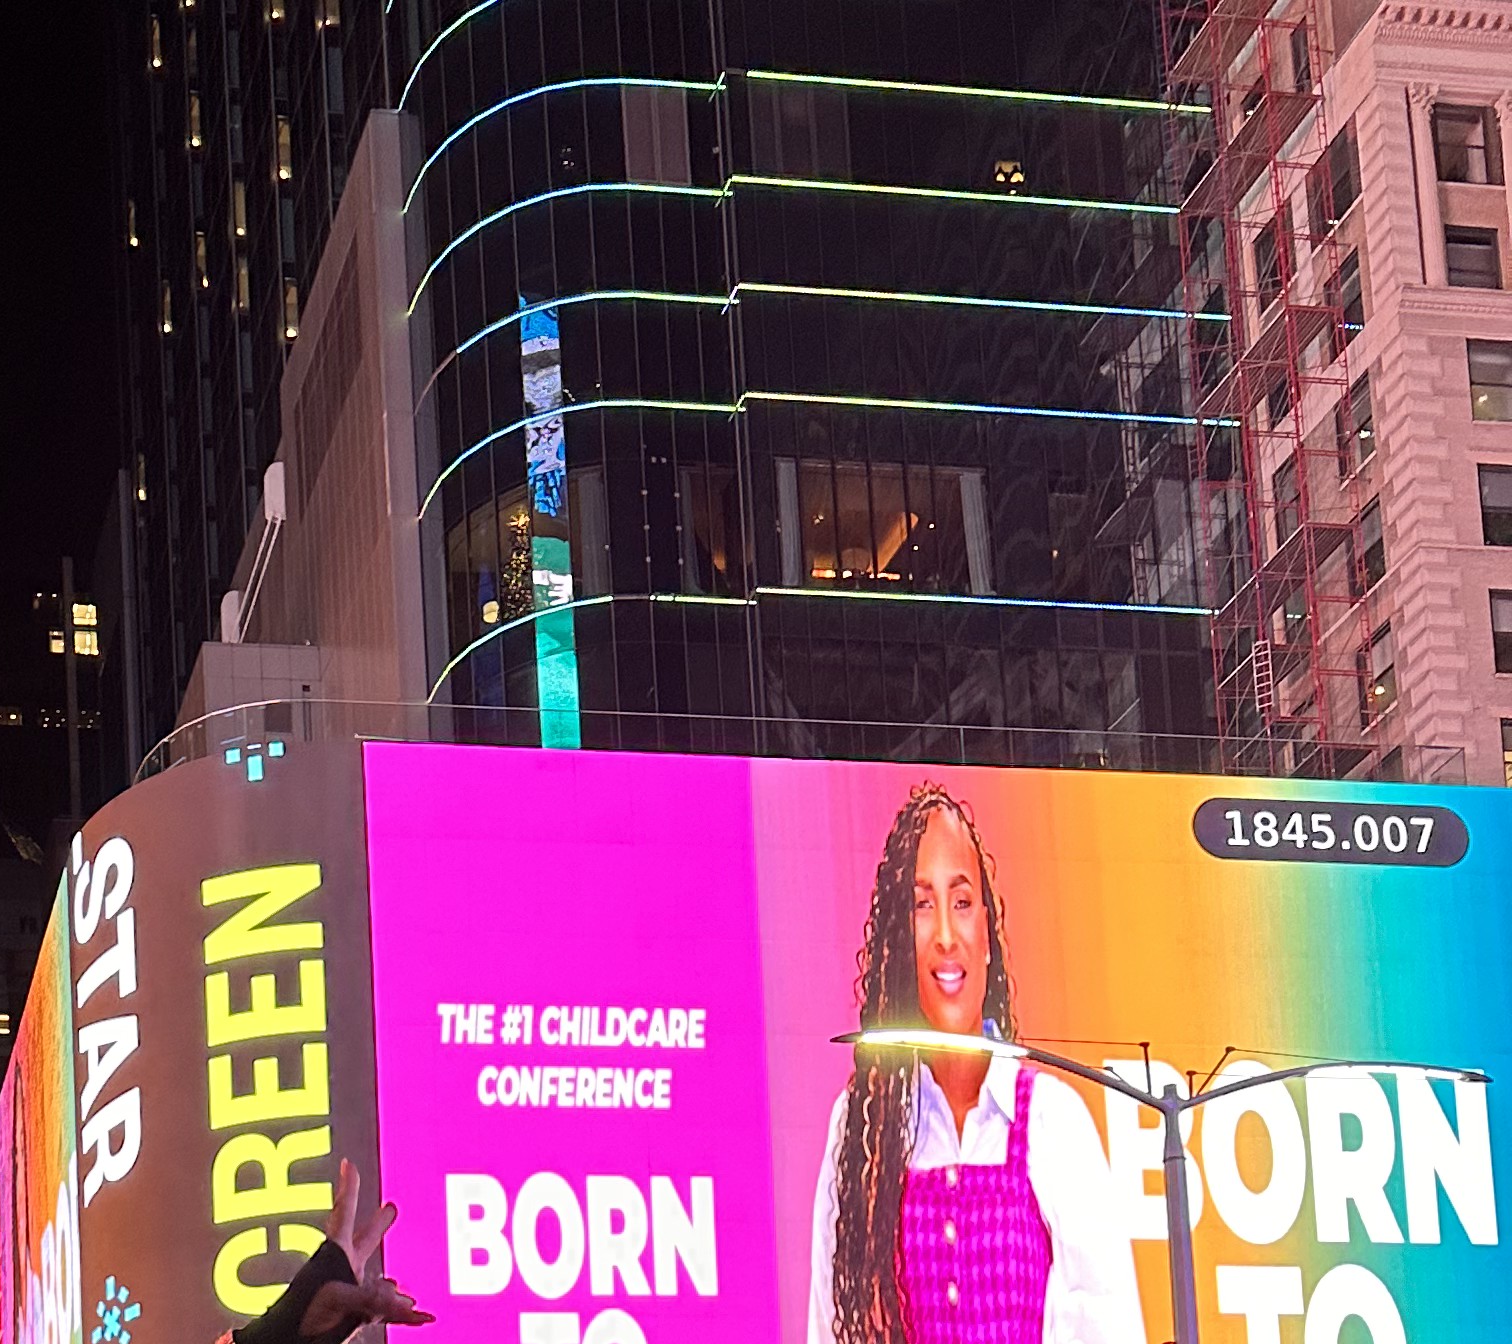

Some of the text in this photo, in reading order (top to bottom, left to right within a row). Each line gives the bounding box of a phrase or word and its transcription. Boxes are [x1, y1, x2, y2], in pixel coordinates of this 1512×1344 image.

[1224, 809, 1435, 854] 1845.007
[72, 831, 143, 1211] STAR
[437, 1003, 707, 1050] THE #1 CHILDCARE
[476, 1065, 673, 1110] CONFERENCE
[1101, 1056, 1499, 1247] BORN
[445, 1171, 719, 1298] BORN
